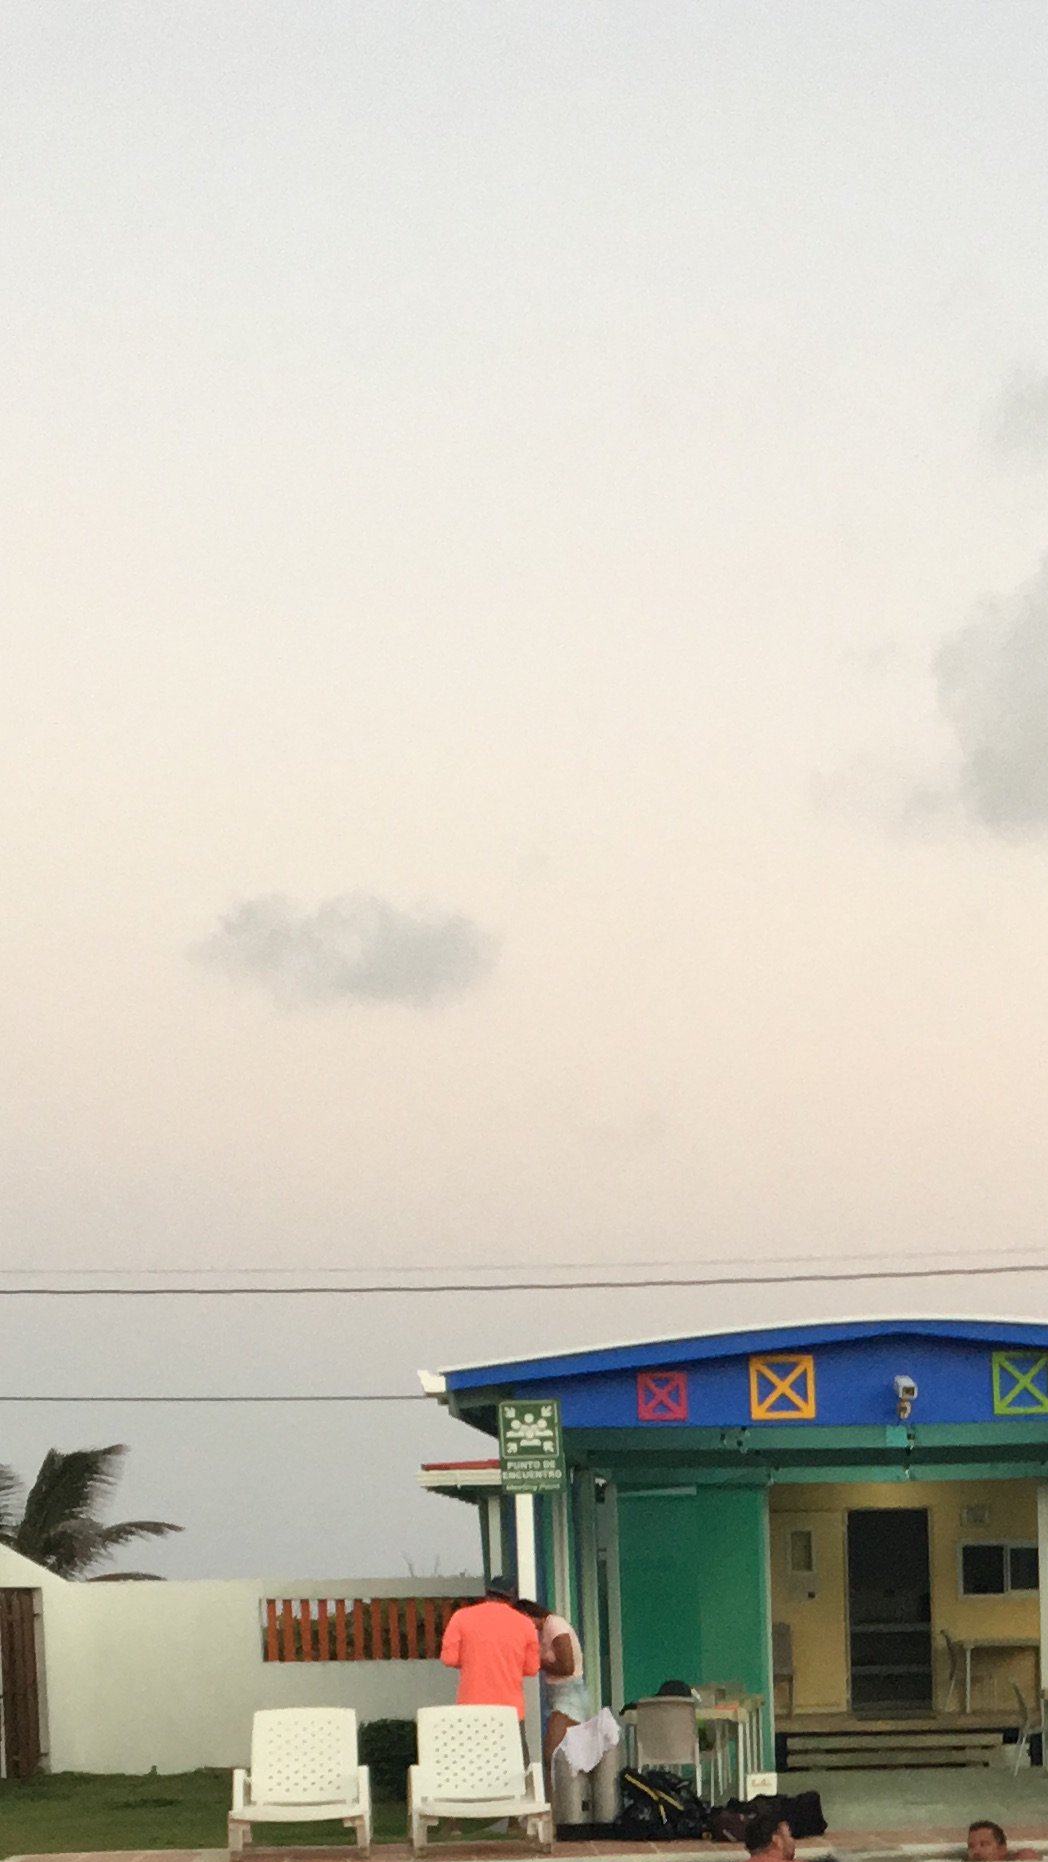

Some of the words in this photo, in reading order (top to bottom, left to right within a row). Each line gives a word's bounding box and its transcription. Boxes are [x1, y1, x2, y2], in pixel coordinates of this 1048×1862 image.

[507, 1461, 541, 1470] PUNTO
[543, 1460, 556, 1469] DE
[502, 1470, 563, 1480] ENCUENTRO
